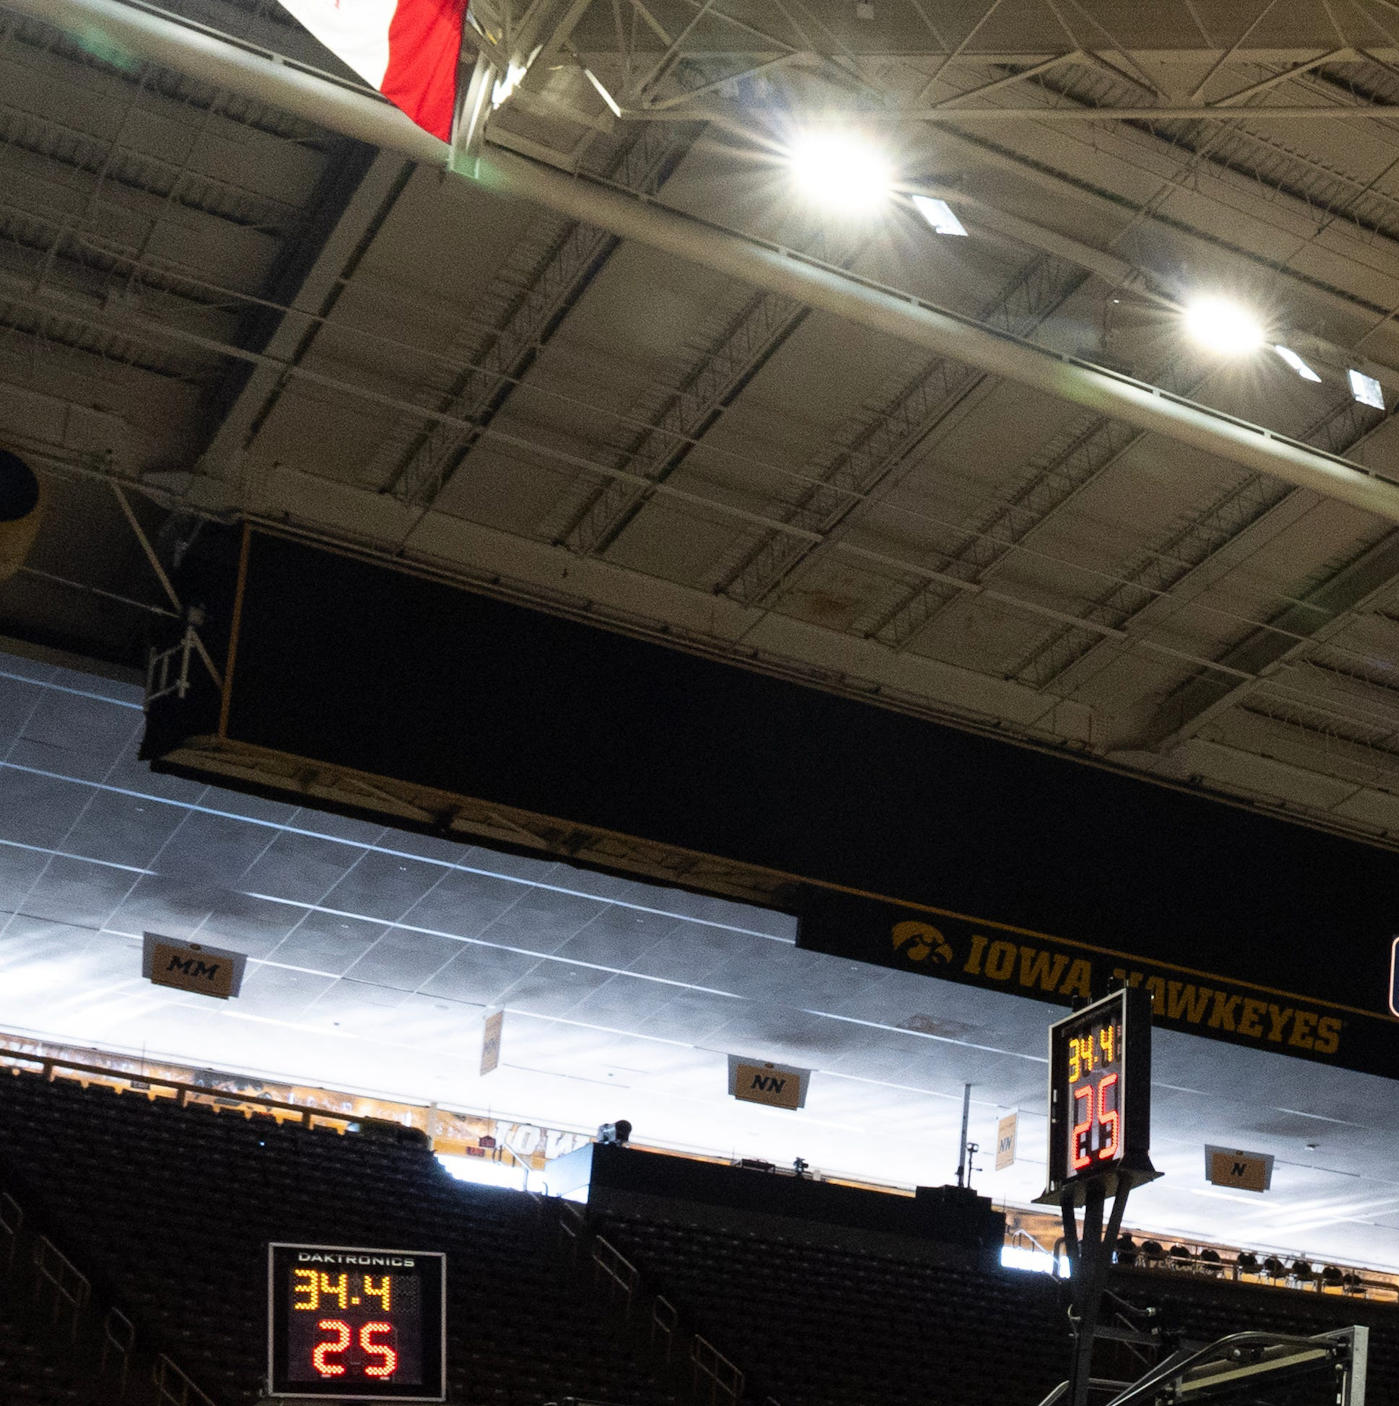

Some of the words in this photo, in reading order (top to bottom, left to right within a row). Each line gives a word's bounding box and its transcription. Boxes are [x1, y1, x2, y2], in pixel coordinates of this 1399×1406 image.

[165, 954, 221, 981] MM
[963, 935, 1092, 998] IOWA
[1069, 1025, 1114, 1084] 34.4
[750, 1073, 787, 1095] NN
[1071, 1072, 1119, 1170] 25
[1231, 1161, 1248, 1178] N
[298, 1253, 415, 1267] DAKTRONICS
[294, 1268, 391, 1312] 34.4
[313, 1319, 397, 1376] 25
